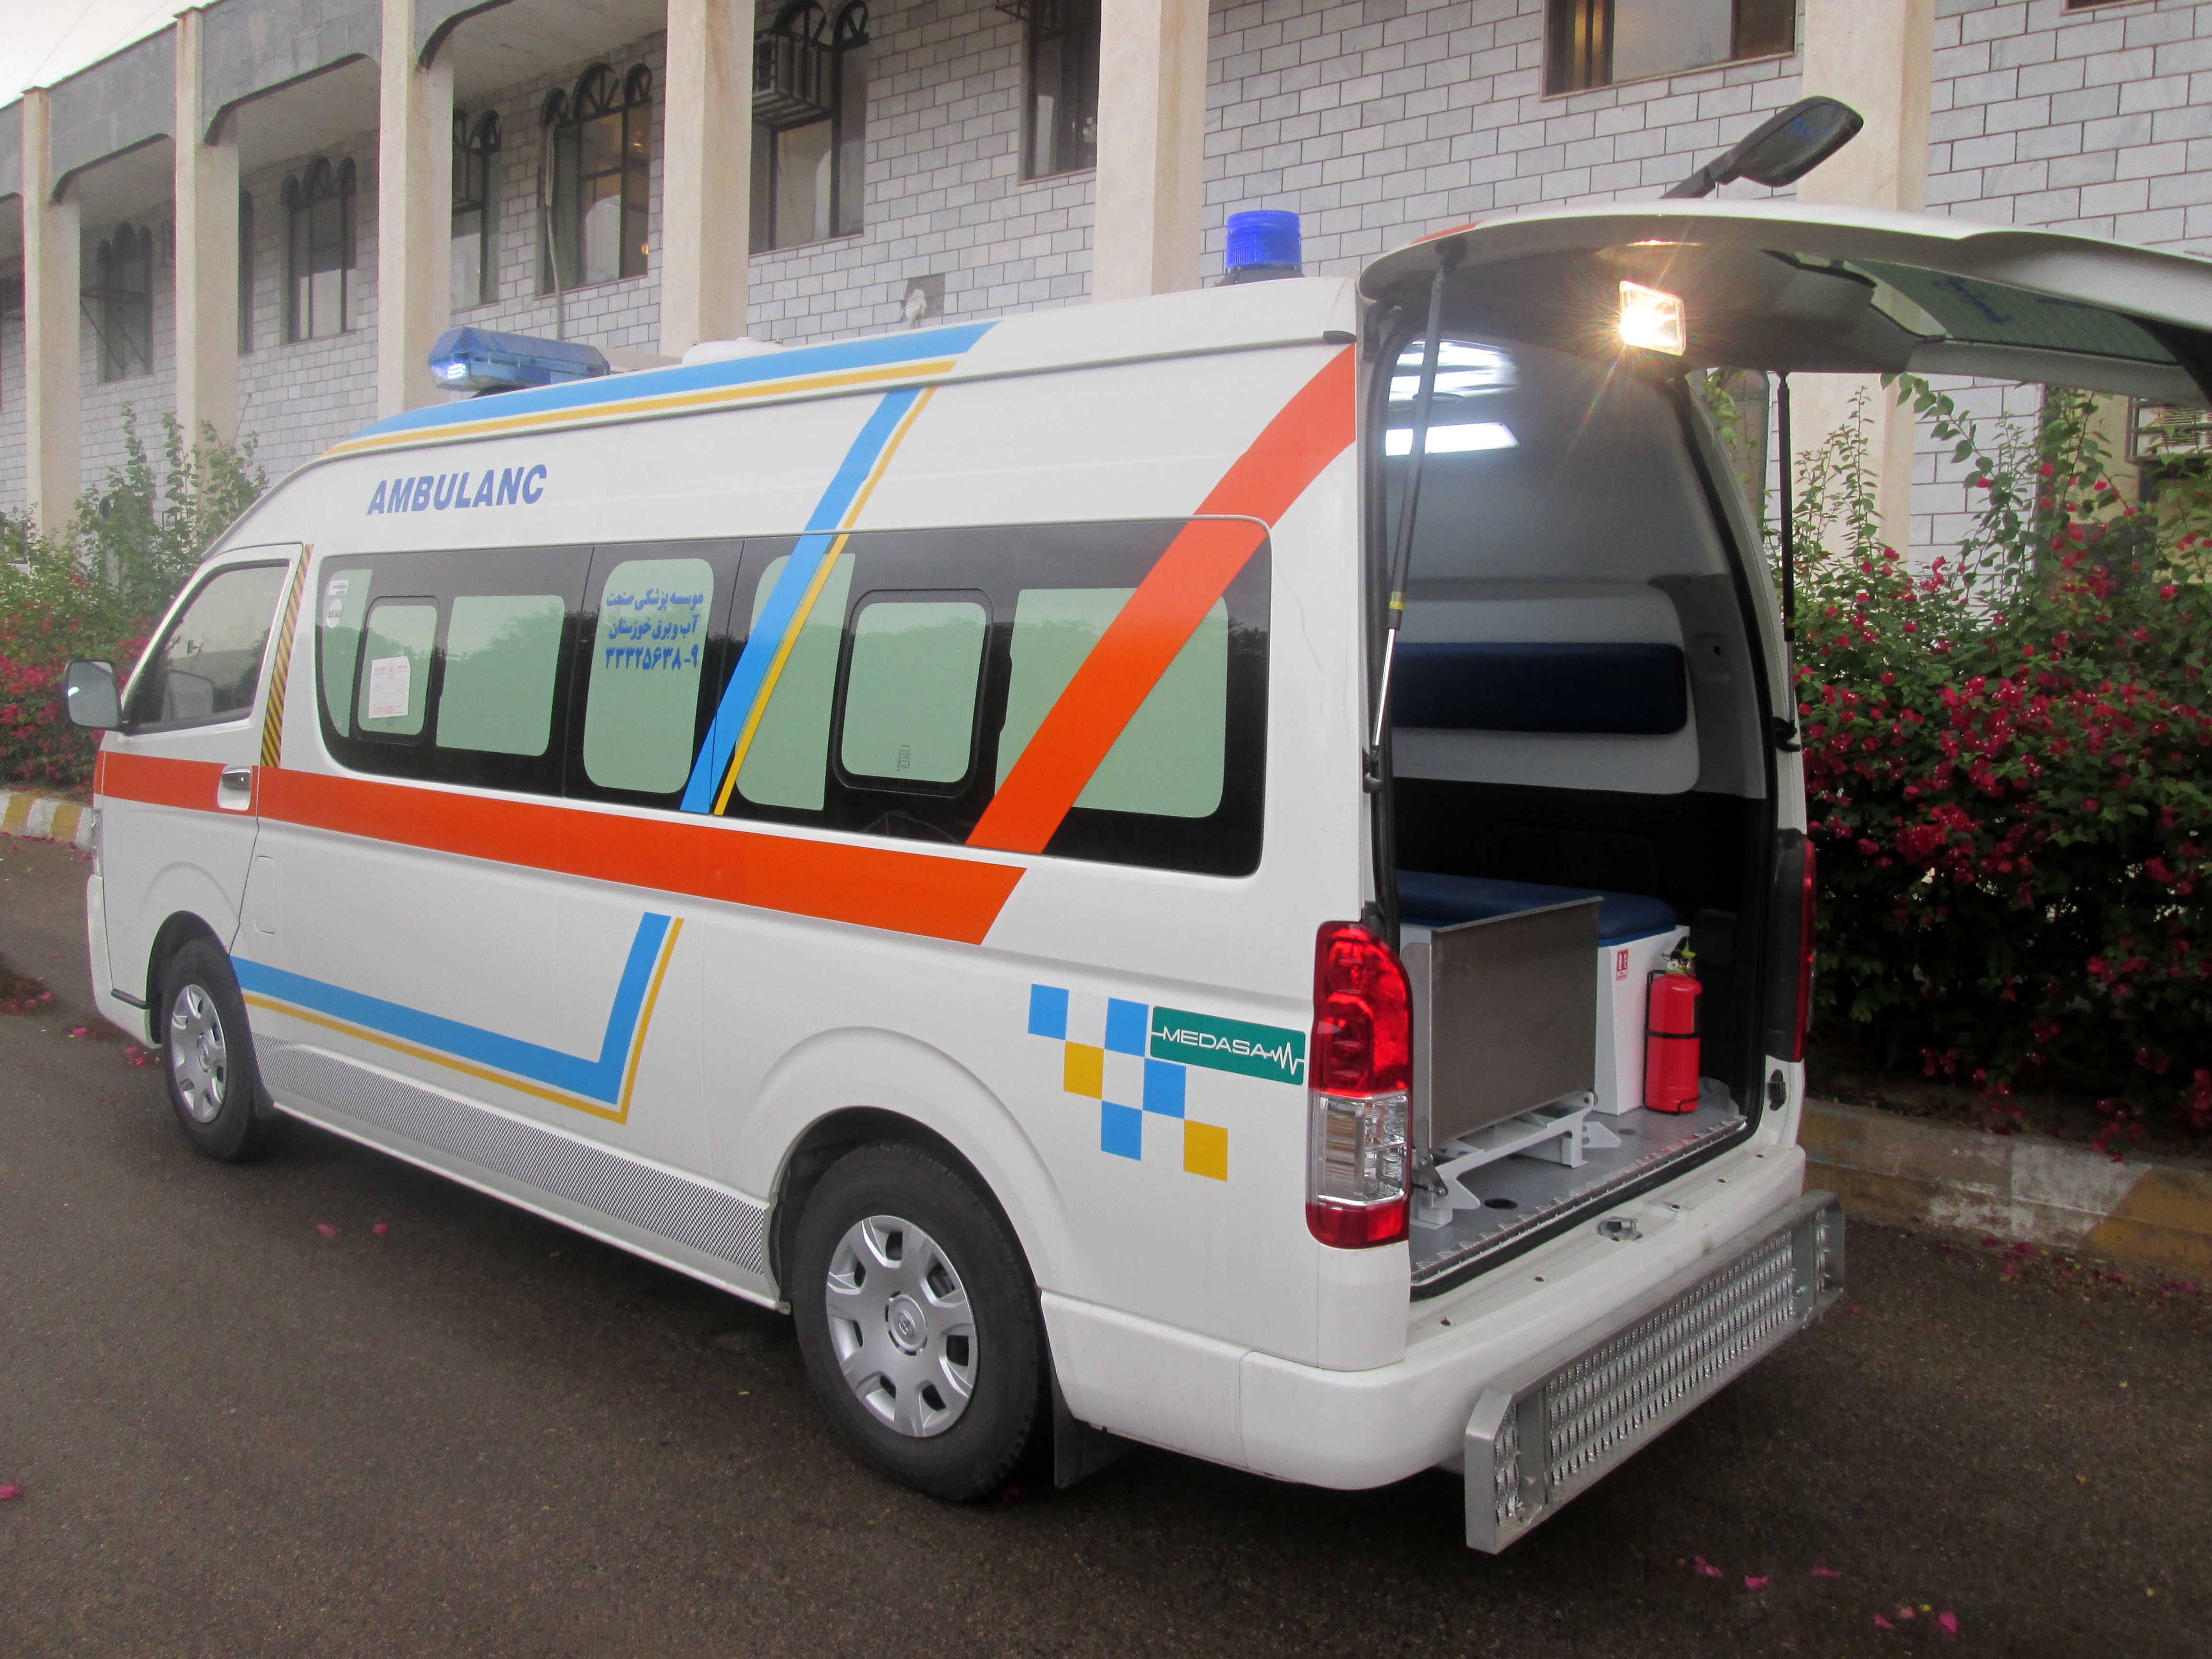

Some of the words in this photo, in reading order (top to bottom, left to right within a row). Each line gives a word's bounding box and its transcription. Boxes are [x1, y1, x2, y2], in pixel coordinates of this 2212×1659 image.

[367, 464, 547, 515] AMBULANC
[606, 591, 634, 606] صنعت
[634, 589, 669, 611] پزشکی
[670, 592, 704, 610] موسسه
[609, 616, 651, 640] خوزستان
[680, 614, 699, 638] آب
[1163, 1026, 1267, 1059] MEDASA
